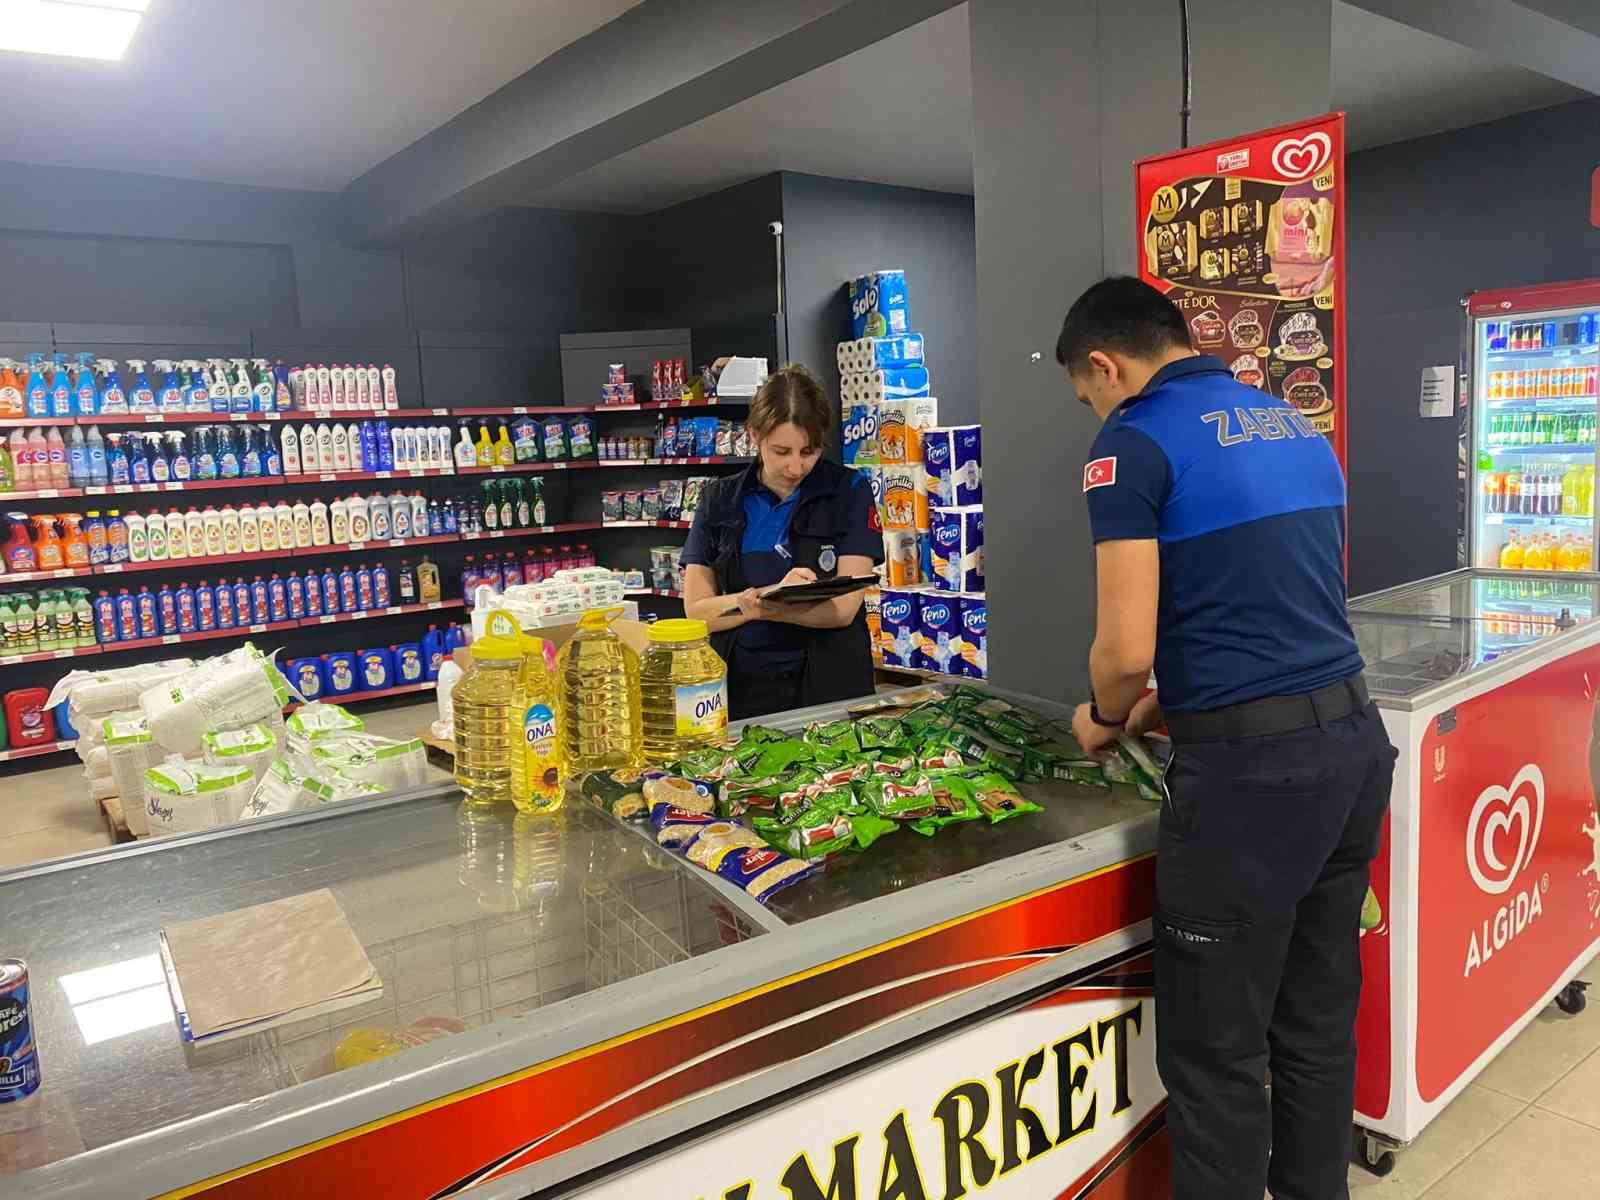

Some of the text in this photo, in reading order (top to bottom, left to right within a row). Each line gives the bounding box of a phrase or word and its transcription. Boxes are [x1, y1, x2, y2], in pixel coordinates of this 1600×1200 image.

[936, 525, 958, 542] Teno
[882, 601, 907, 618] Teno
[922, 605, 946, 623] Teno
[696, 692, 722, 719] ONA
[526, 722, 554, 742] ONA
[779, 1000, 1144, 1200] MARKET
